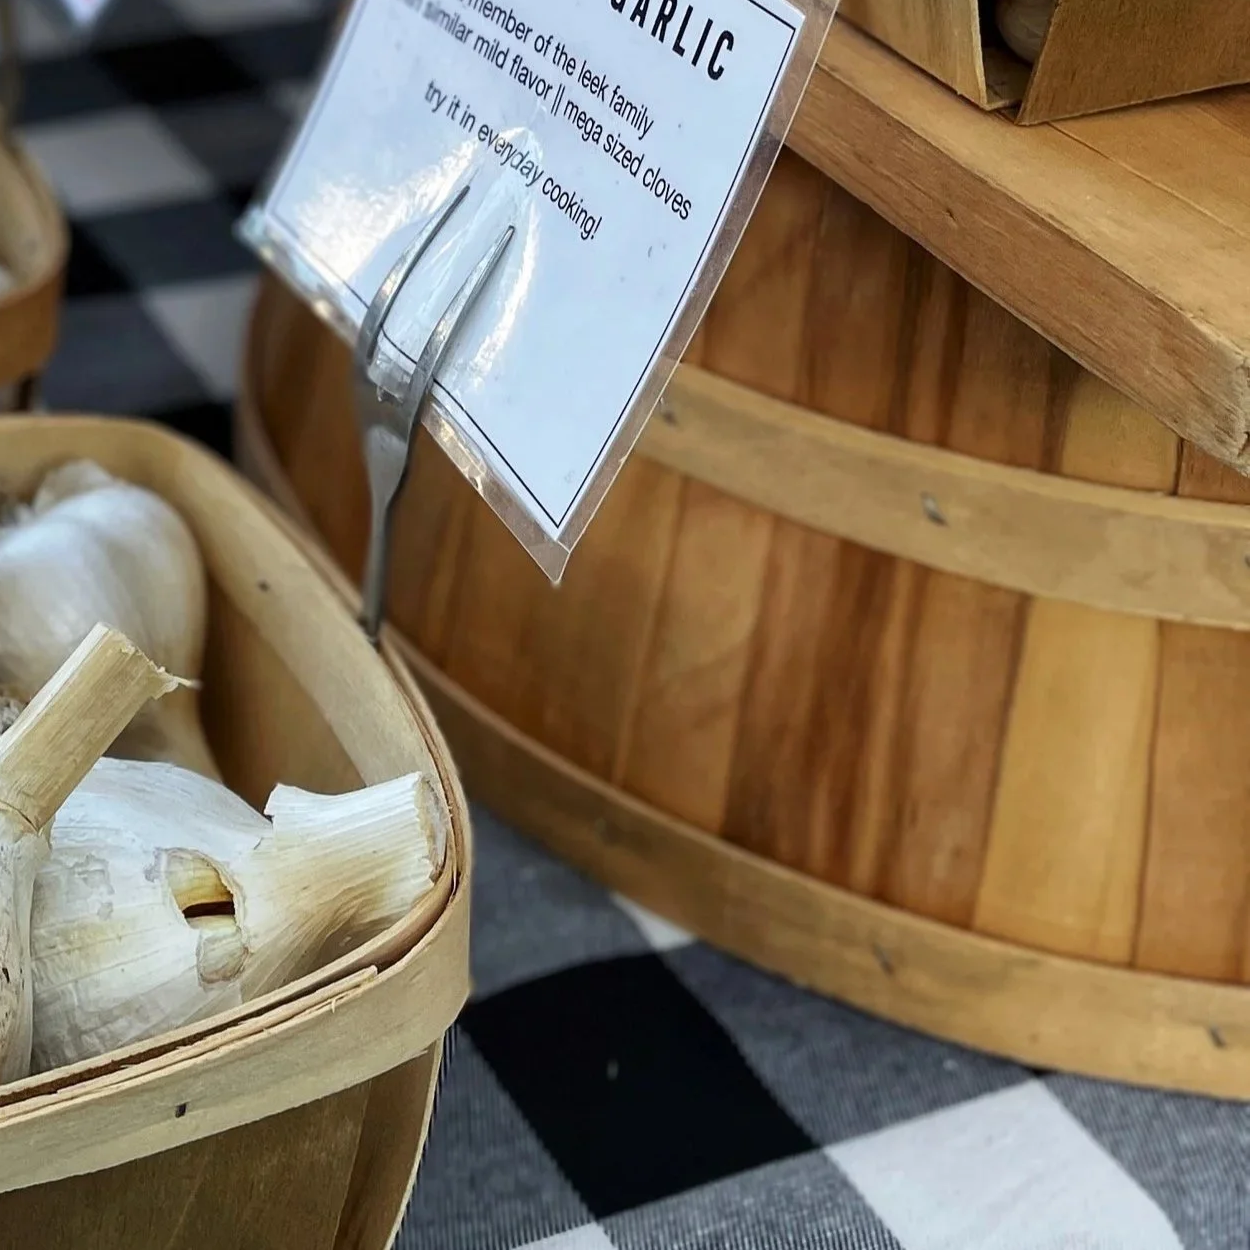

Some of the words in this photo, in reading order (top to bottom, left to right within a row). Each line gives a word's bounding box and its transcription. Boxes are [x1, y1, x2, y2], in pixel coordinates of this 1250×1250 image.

[422, 0, 474, 44] similar
[473, 35, 510, 70] mild
[509, 54, 553, 100] flavor
[563, 100, 603, 145] mega
[603, 133, 645, 178] sized
[642, 167, 692, 221] cloves
[424, 80, 447, 113] try
[446, 95, 461, 121] it
[459, 104, 476, 133] in
[477, 123, 545, 188] everyday
[541, 177, 603, 241] cooking!
[533, 35, 554, 57] of
[552, 42, 576, 76] the
[577, 60, 609, 102] leek
[608, 85, 655, 140] family
